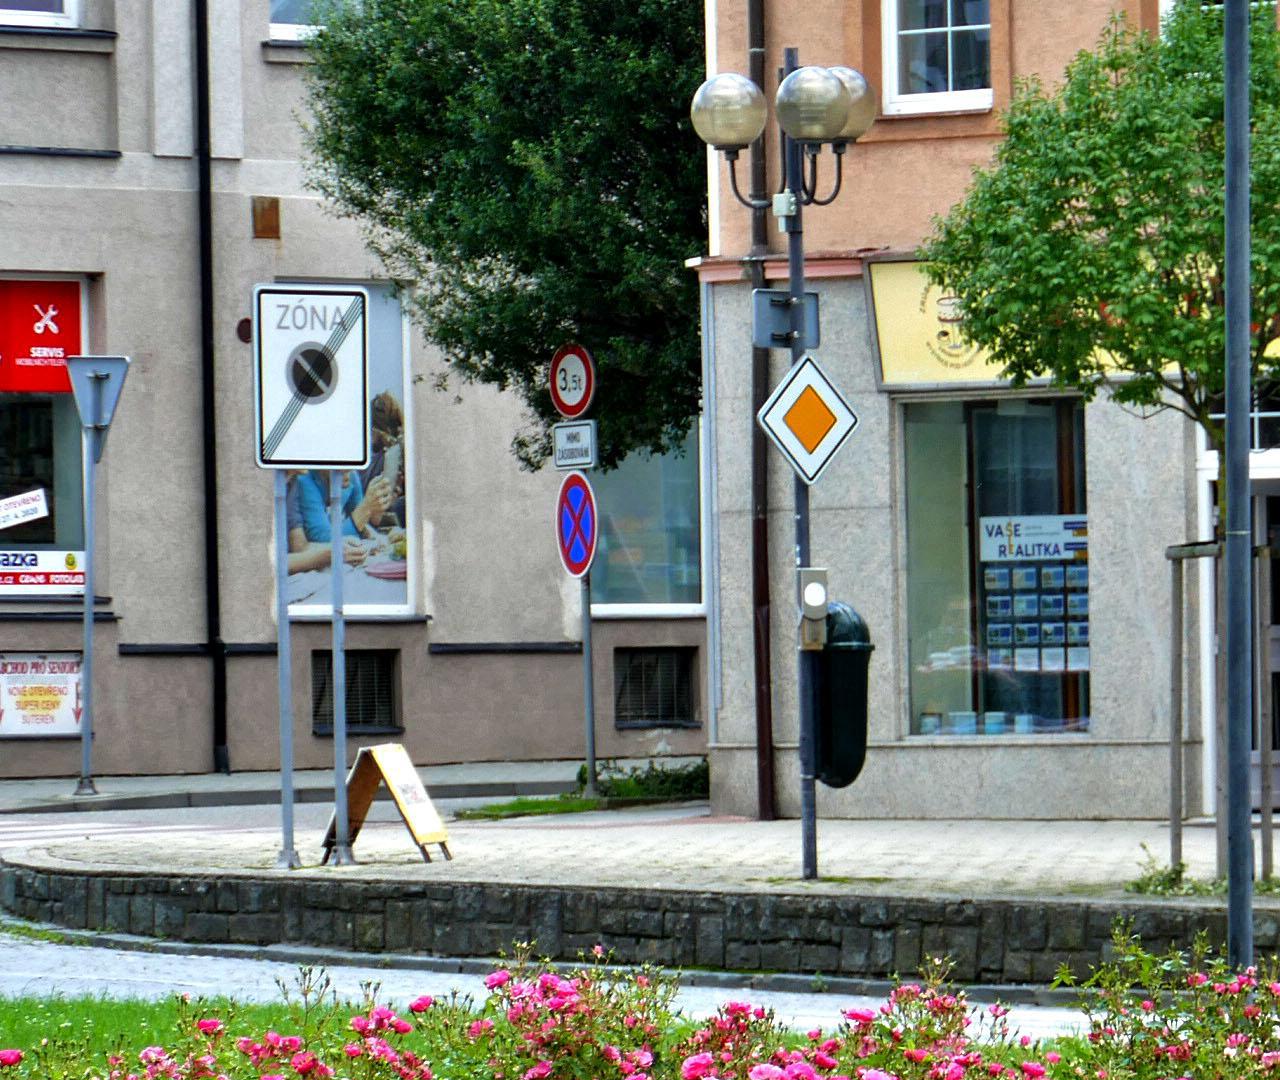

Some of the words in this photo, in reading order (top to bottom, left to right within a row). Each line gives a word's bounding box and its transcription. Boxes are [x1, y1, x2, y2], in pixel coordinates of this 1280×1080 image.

[275, 298, 348, 330] ZÓNA
[30, 347, 64, 358] SERVIS
[559, 367, 583, 393] 3,5t
[0, 552, 38, 567] azka
[30, 661, 46, 674] PRO
[40, 700, 60, 711] CENY
